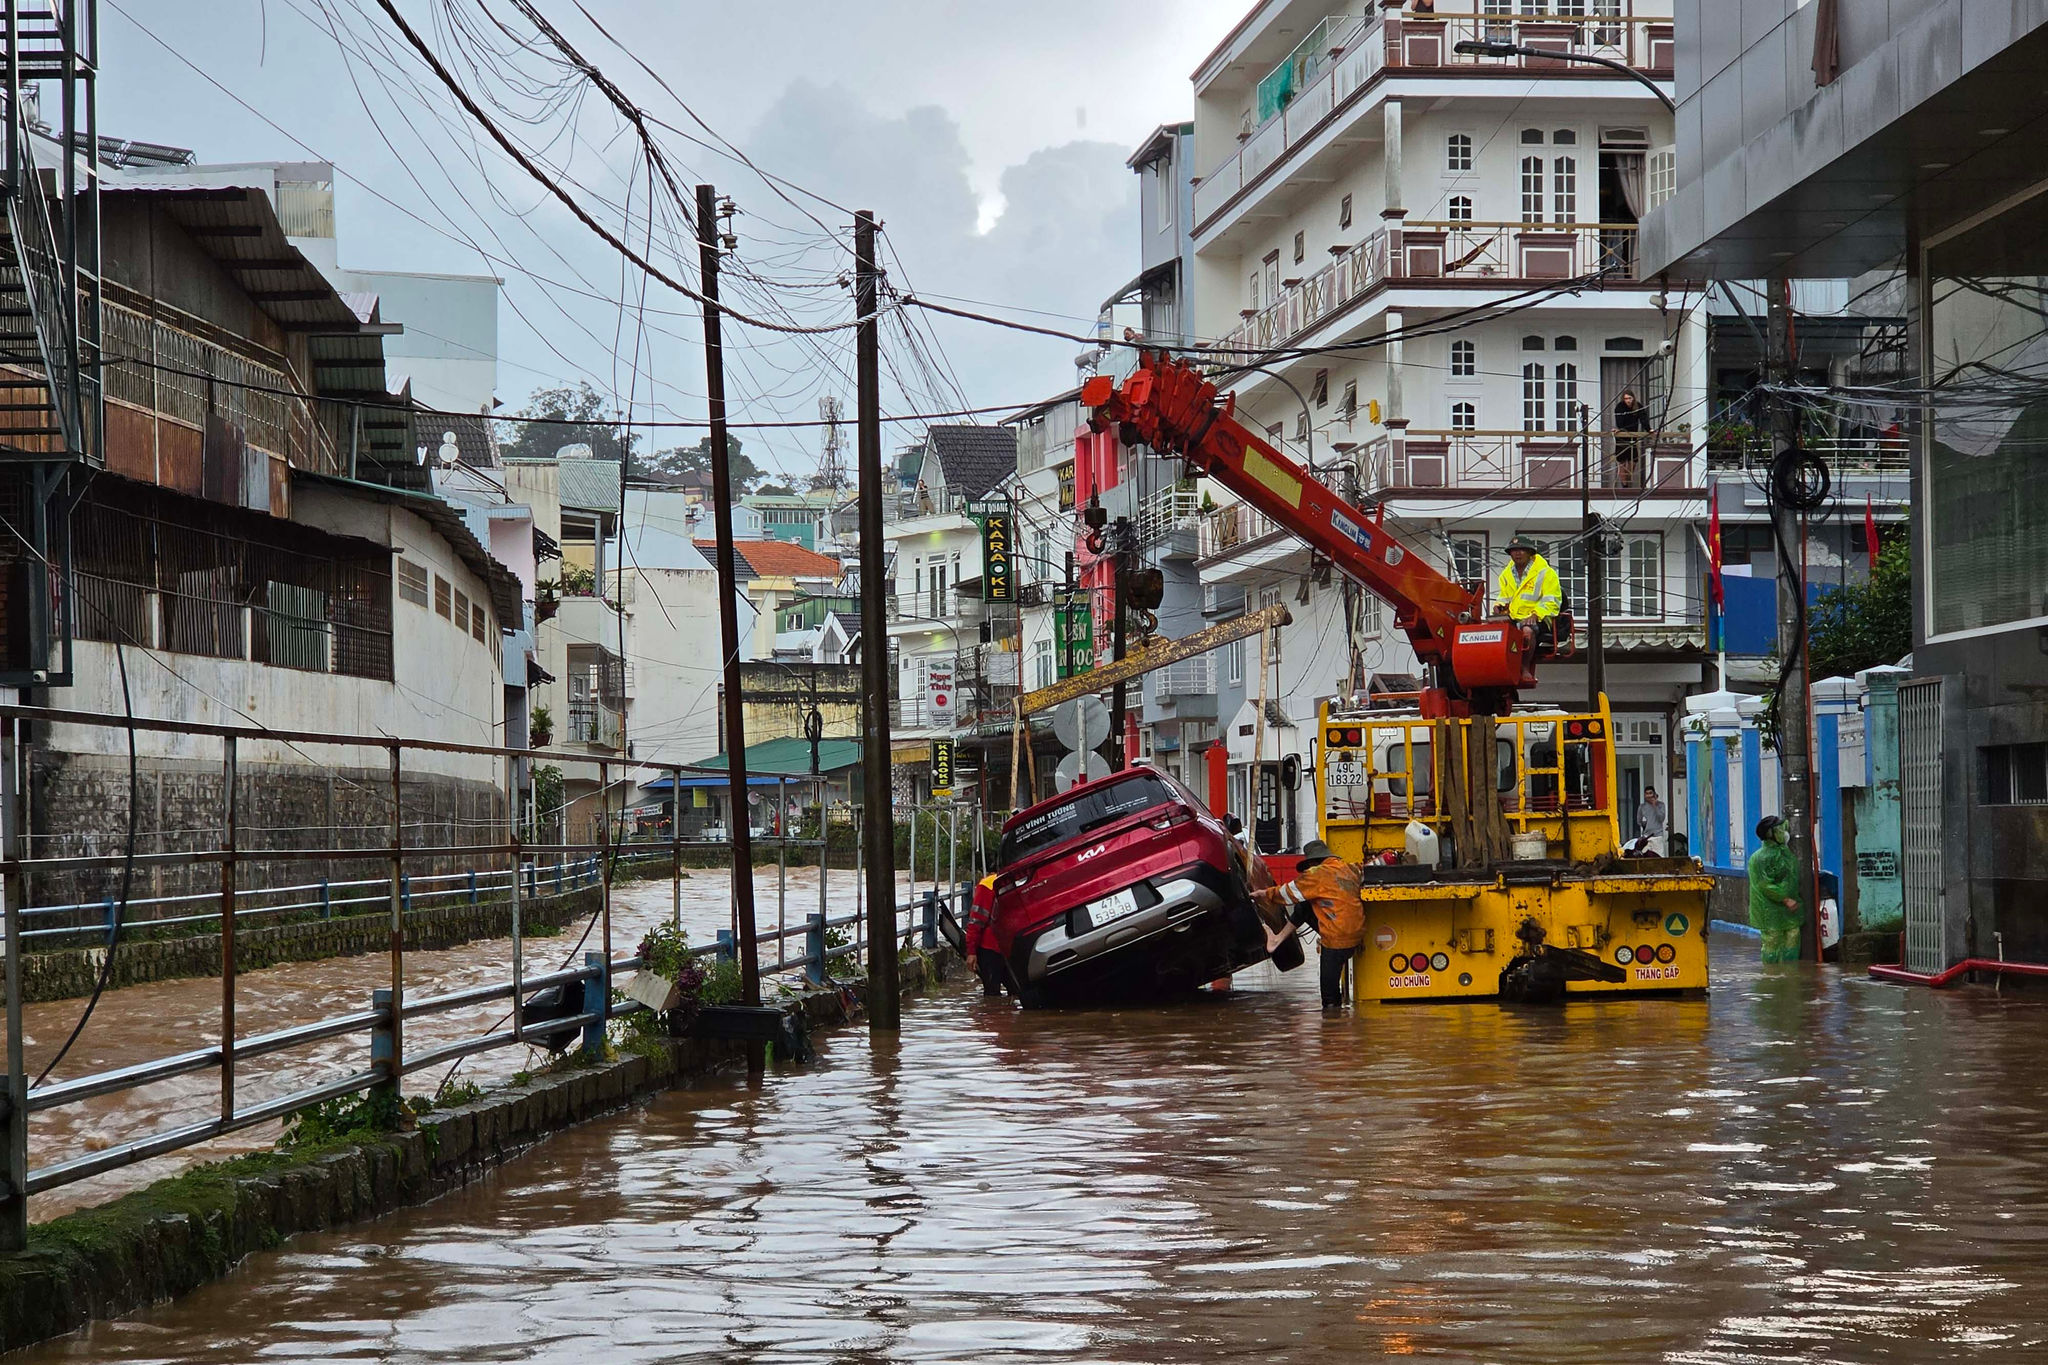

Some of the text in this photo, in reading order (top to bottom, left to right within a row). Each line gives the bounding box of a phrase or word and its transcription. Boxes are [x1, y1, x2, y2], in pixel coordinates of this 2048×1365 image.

[989, 519, 1008, 598] KARAOKE
[1461, 634, 1499, 642] KANGLIM
[938, 744, 949, 785] KARAOKE
[1336, 763, 1354, 773] 49C
[1330, 774, 1361, 785] 183.22
[1077, 844, 1105, 862] KIA
[1101, 895, 1121, 909] 47A
[1095, 903, 1132, 923] 539.38
[1389, 976, 1402, 988] COI
